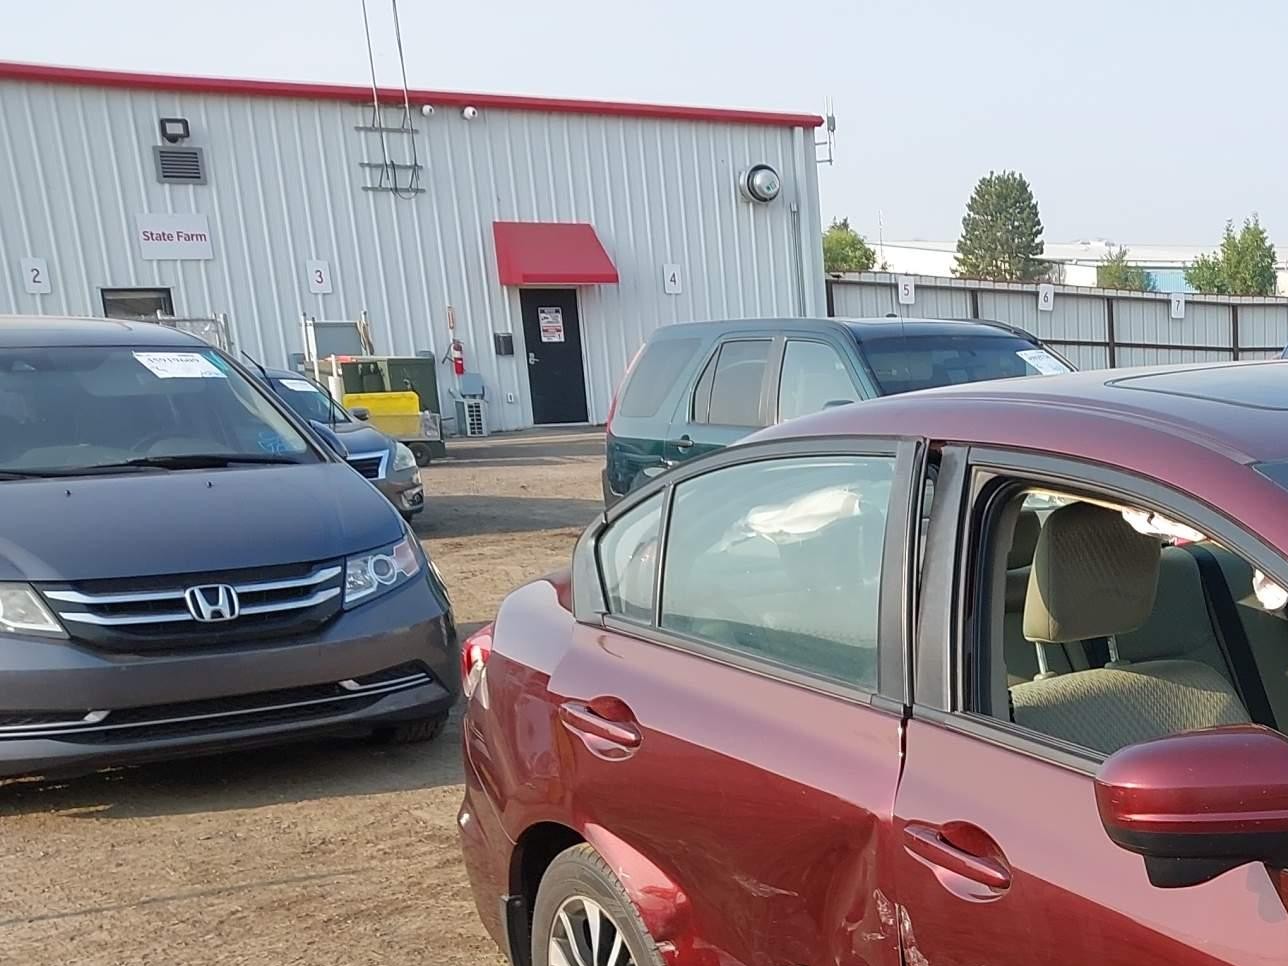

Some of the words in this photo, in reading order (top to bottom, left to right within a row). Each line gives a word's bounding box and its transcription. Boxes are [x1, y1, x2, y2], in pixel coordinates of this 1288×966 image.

[142, 230, 174, 242] State
[175, 230, 207, 243] Farm
[31, 268, 42, 284] 2
[315, 269, 324, 284] 3
[669, 271, 677, 286] 4
[903, 284, 910, 296] 5
[1043, 291, 1049, 303] 6
[1175, 300, 1181, 312] 7
